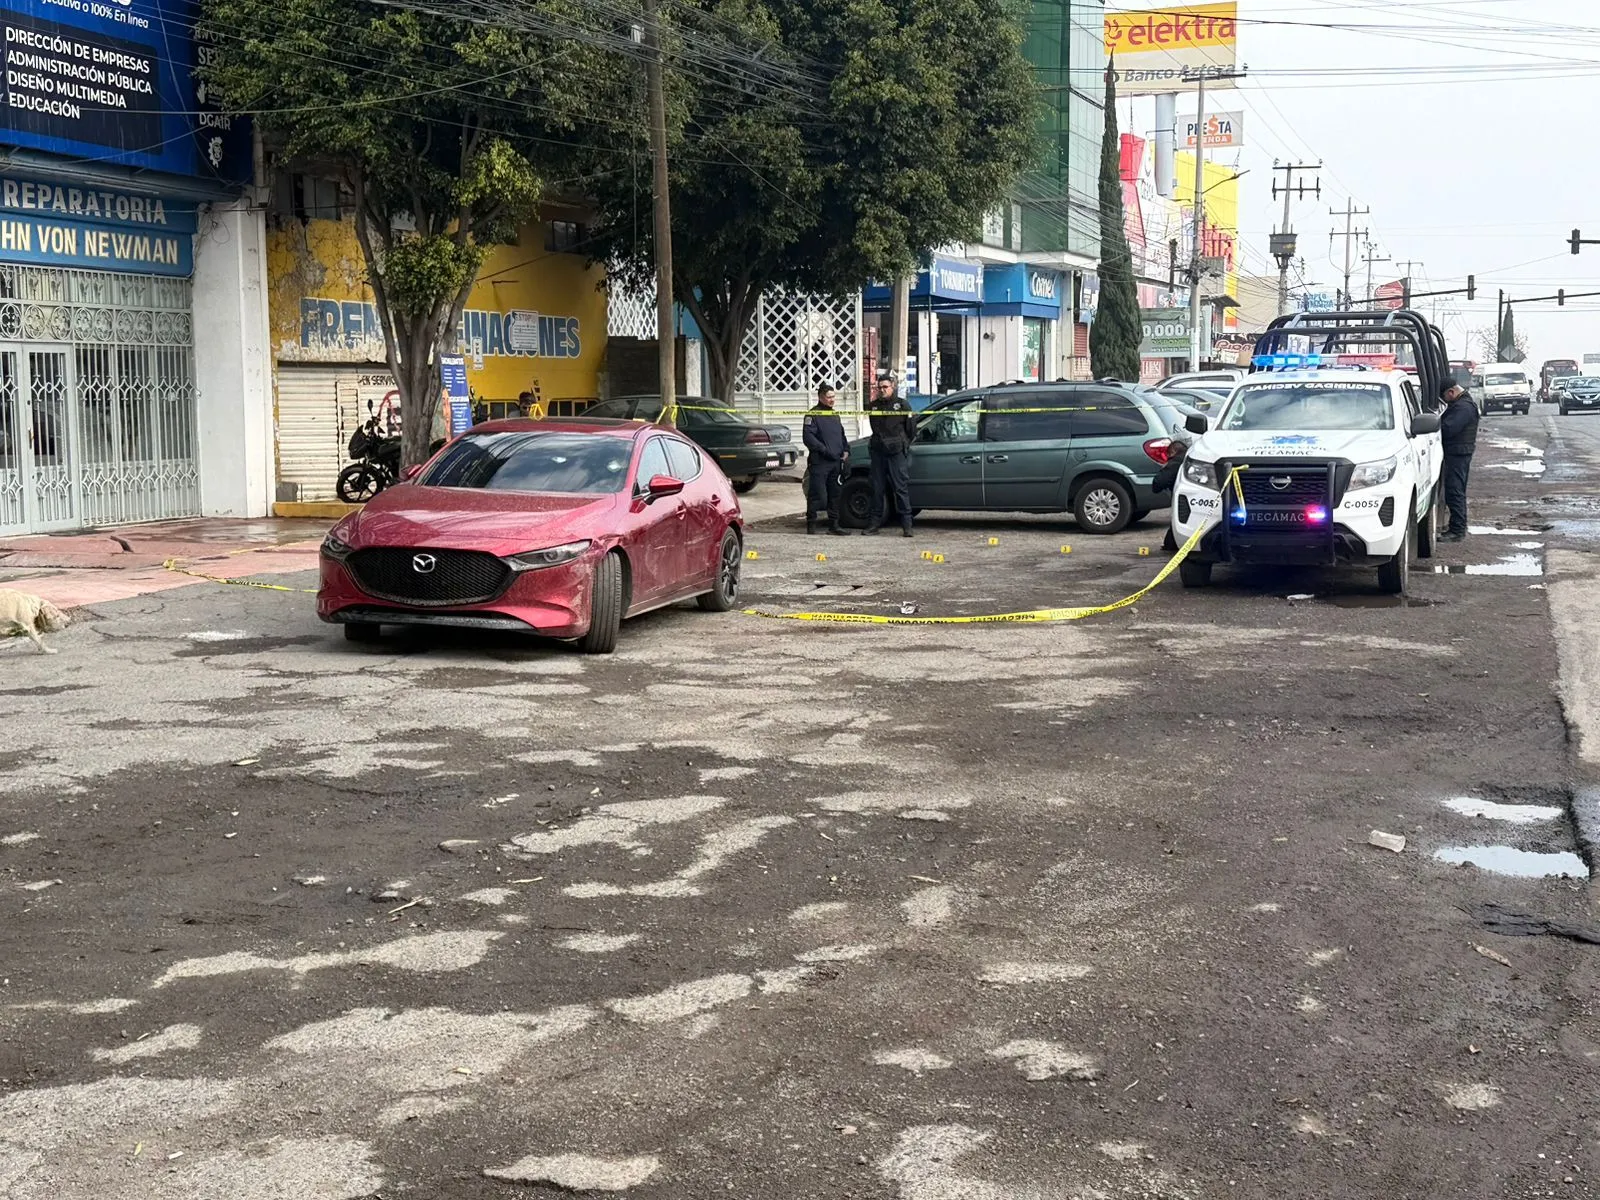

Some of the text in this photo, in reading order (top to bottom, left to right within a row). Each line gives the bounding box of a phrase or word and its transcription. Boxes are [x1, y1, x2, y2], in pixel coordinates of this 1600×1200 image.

[82, 3, 89, 13] o
[91, 3, 113, 19] 100%
[114, 9, 126, 23] En
[128, 7, 149, 29] línea
[1128, 14, 1236, 46] elektra
[6, 26, 150, 74] DIRECCIÓN DE EMPRESAS
[7, 50, 153, 95] ADMINISTRACIÓN PÚBLICA
[1124, 64, 1236, 83] Banco Azteca
[8, 70, 127, 108] DISEÑO MULTIMEDIA
[9, 92, 80, 119] EDUCACIÓN
[200, 113, 231, 131] DGAIR
[3, 179, 167, 225] REPARATORIA
[1, 219, 178, 265] HN VON NEWMAN
[1032, 271, 1058, 299] Comex
[1250, 512, 1306, 522] TECAMAC
[1344, 500, 1380, 509] C-0055
